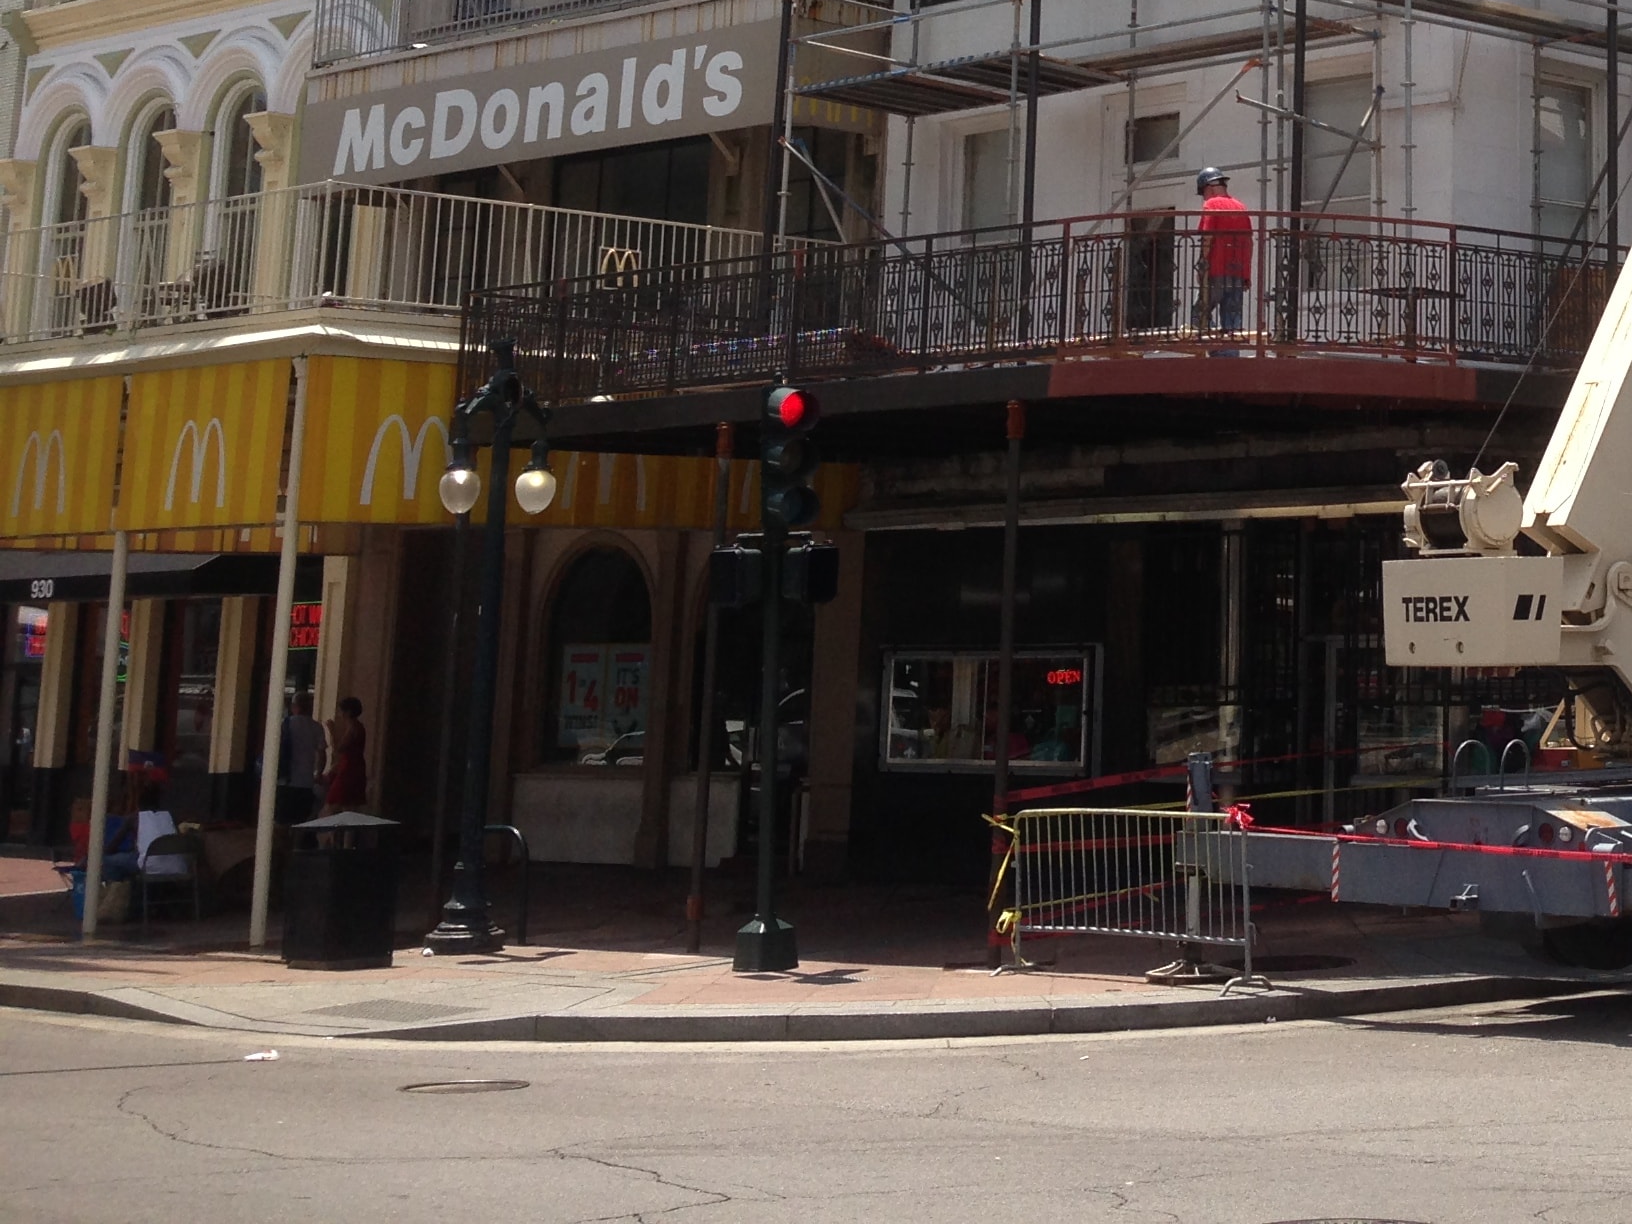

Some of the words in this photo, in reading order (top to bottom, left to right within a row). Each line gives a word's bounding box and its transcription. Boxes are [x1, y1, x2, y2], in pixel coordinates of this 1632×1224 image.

[333, 44, 743, 176] McDonald's
[31, 579, 54, 598] 930
[1402, 596, 1471, 622] TEREX
[1047, 669, 1081, 685] OPEN
